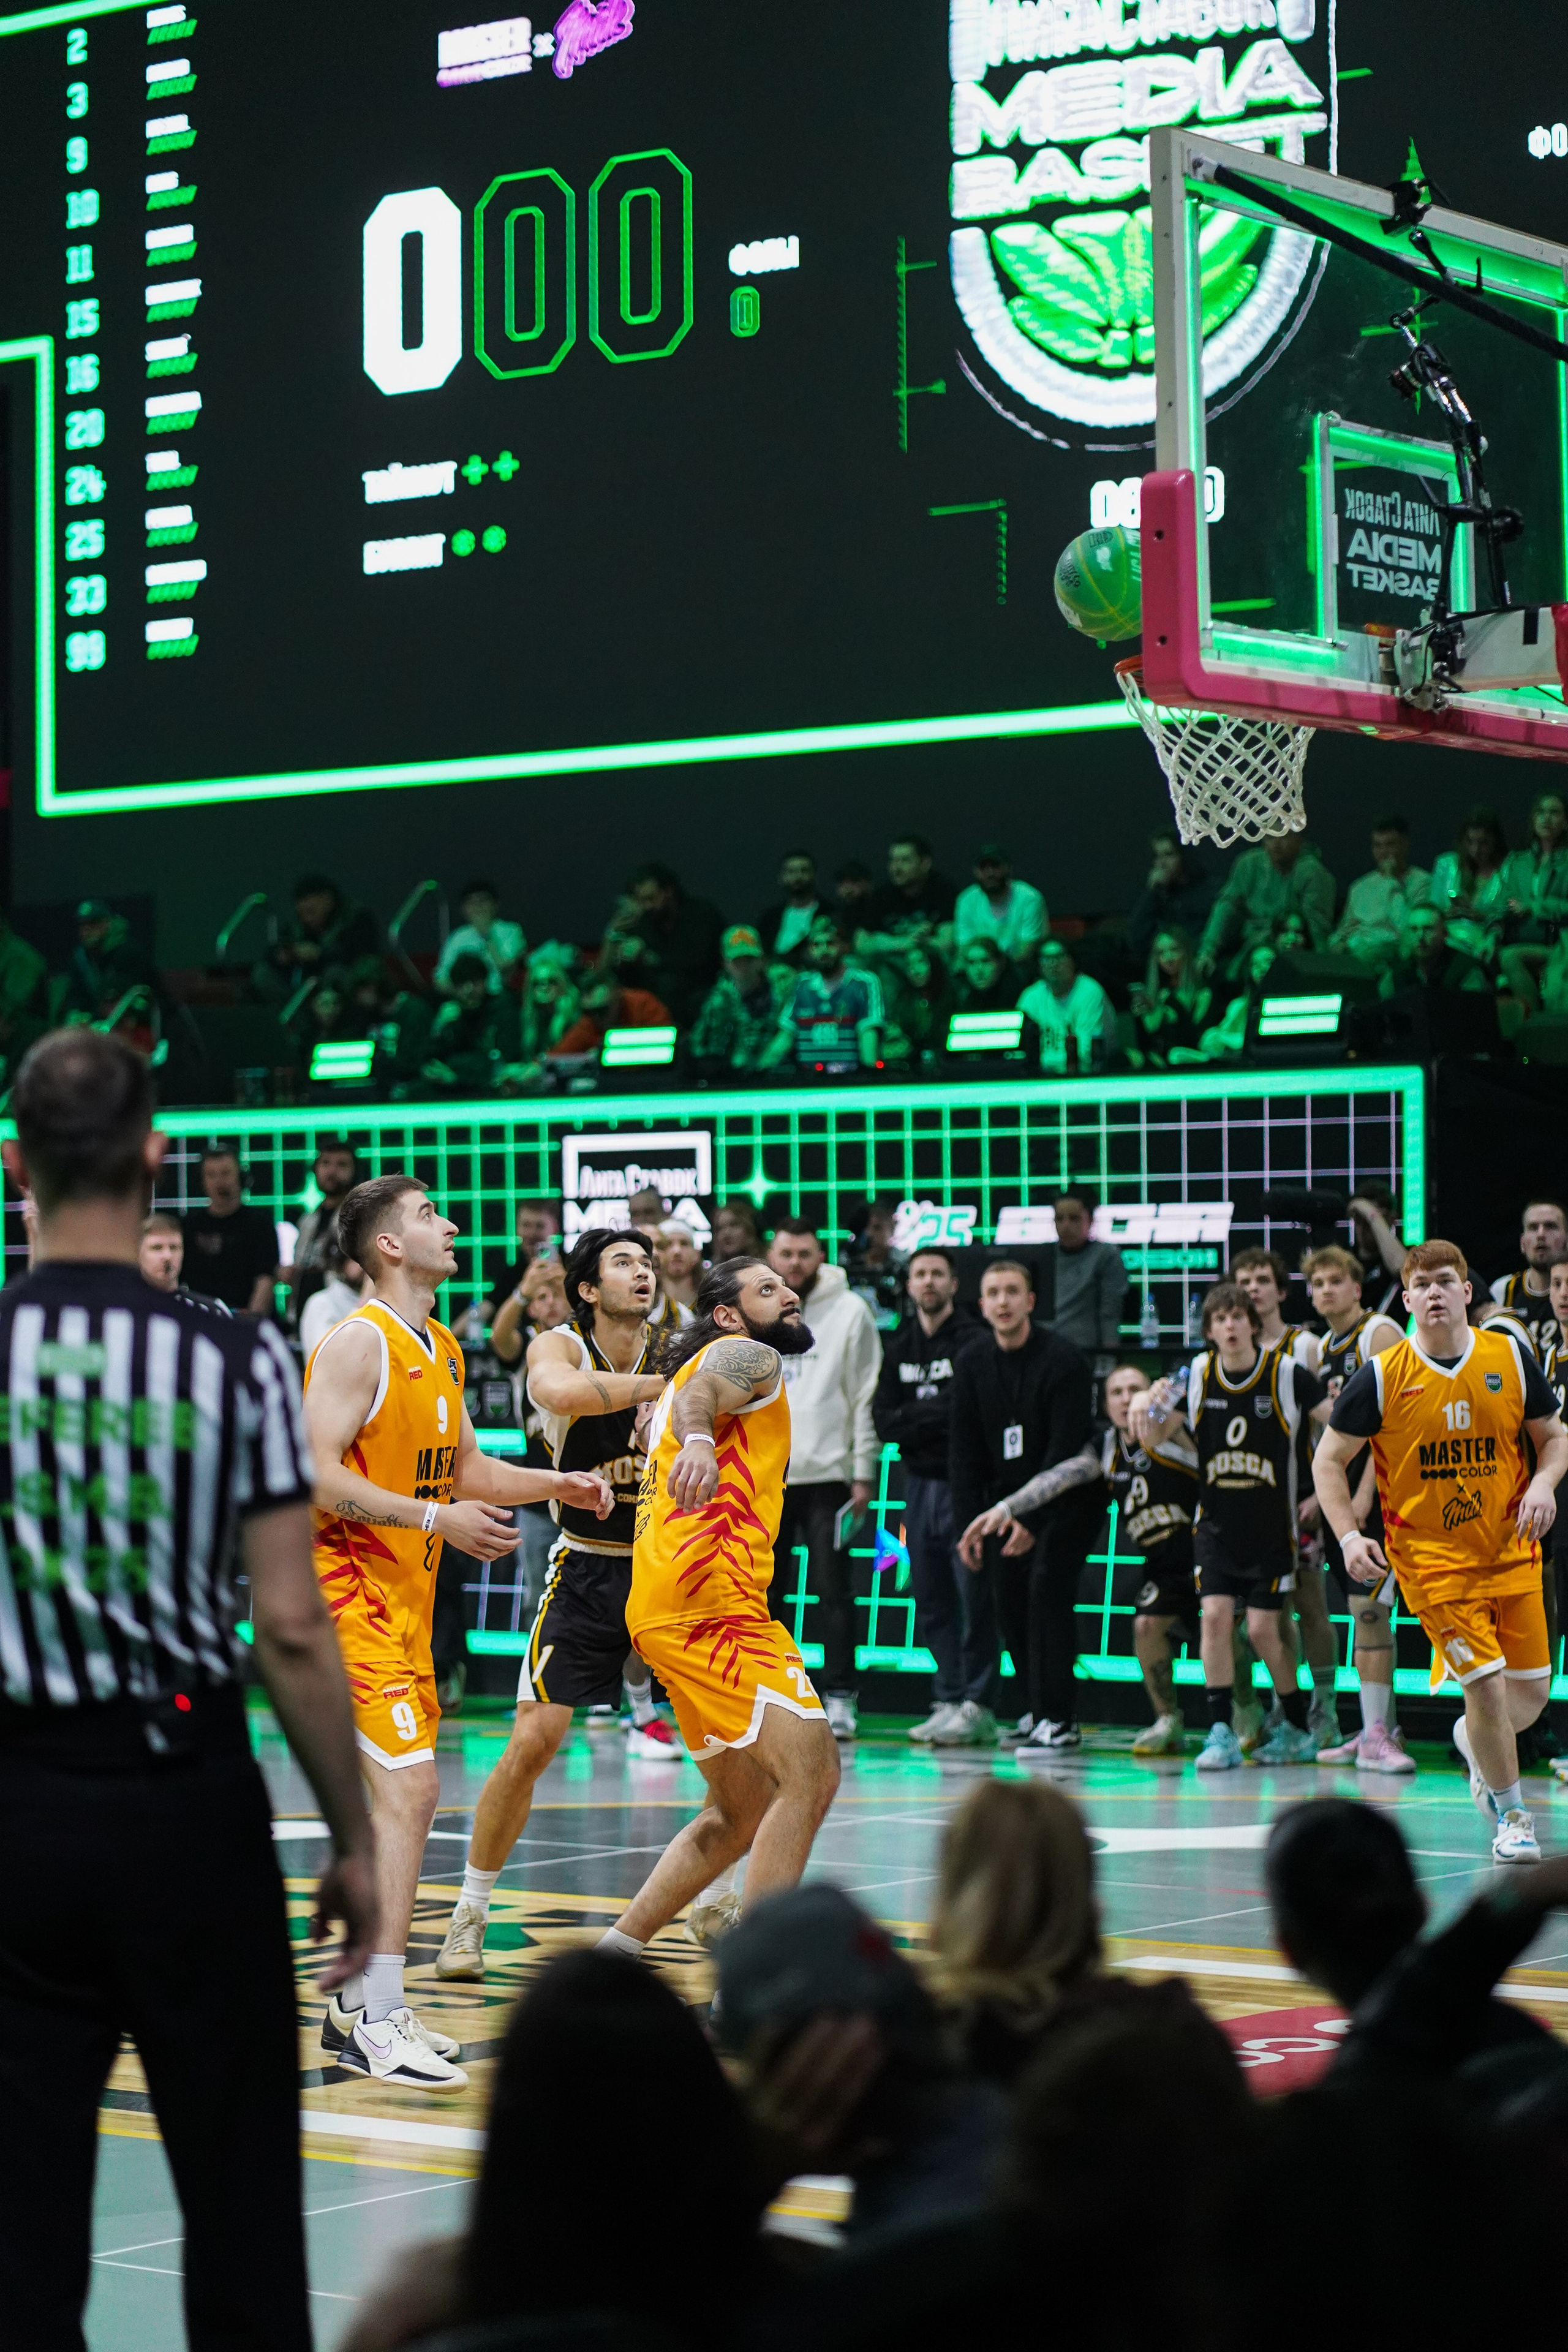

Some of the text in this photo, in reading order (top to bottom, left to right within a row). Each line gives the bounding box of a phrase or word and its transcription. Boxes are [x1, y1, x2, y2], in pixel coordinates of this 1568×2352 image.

[67, 28, 88, 65] 2
[66, 81, 88, 119] 3
[949, 38, 1325, 155] MEDIA
[66, 136, 88, 173] 9
[949, 111, 1327, 220] BAST
[66, 244, 94, 284] 11
[66, 298, 100, 339] 15
[730, 285, 760, 337] 0
[66, 353, 100, 394] 16
[65, 464, 107, 506] 24
[65, 519, 105, 562] 25
[409, 1370, 423, 1381] RED
[437, 1395, 448, 1435] 9
[1226, 1415, 1248, 1447] 0
[1442, 1400, 1471, 1432] 16
[1419, 1435, 1496, 1466] MASTER
[1459, 1464, 1497, 1479] COLOR
[1446, 1636, 1475, 1667] 16
[383, 1687, 409, 1699] RED
[391, 1702, 417, 1740] 9
